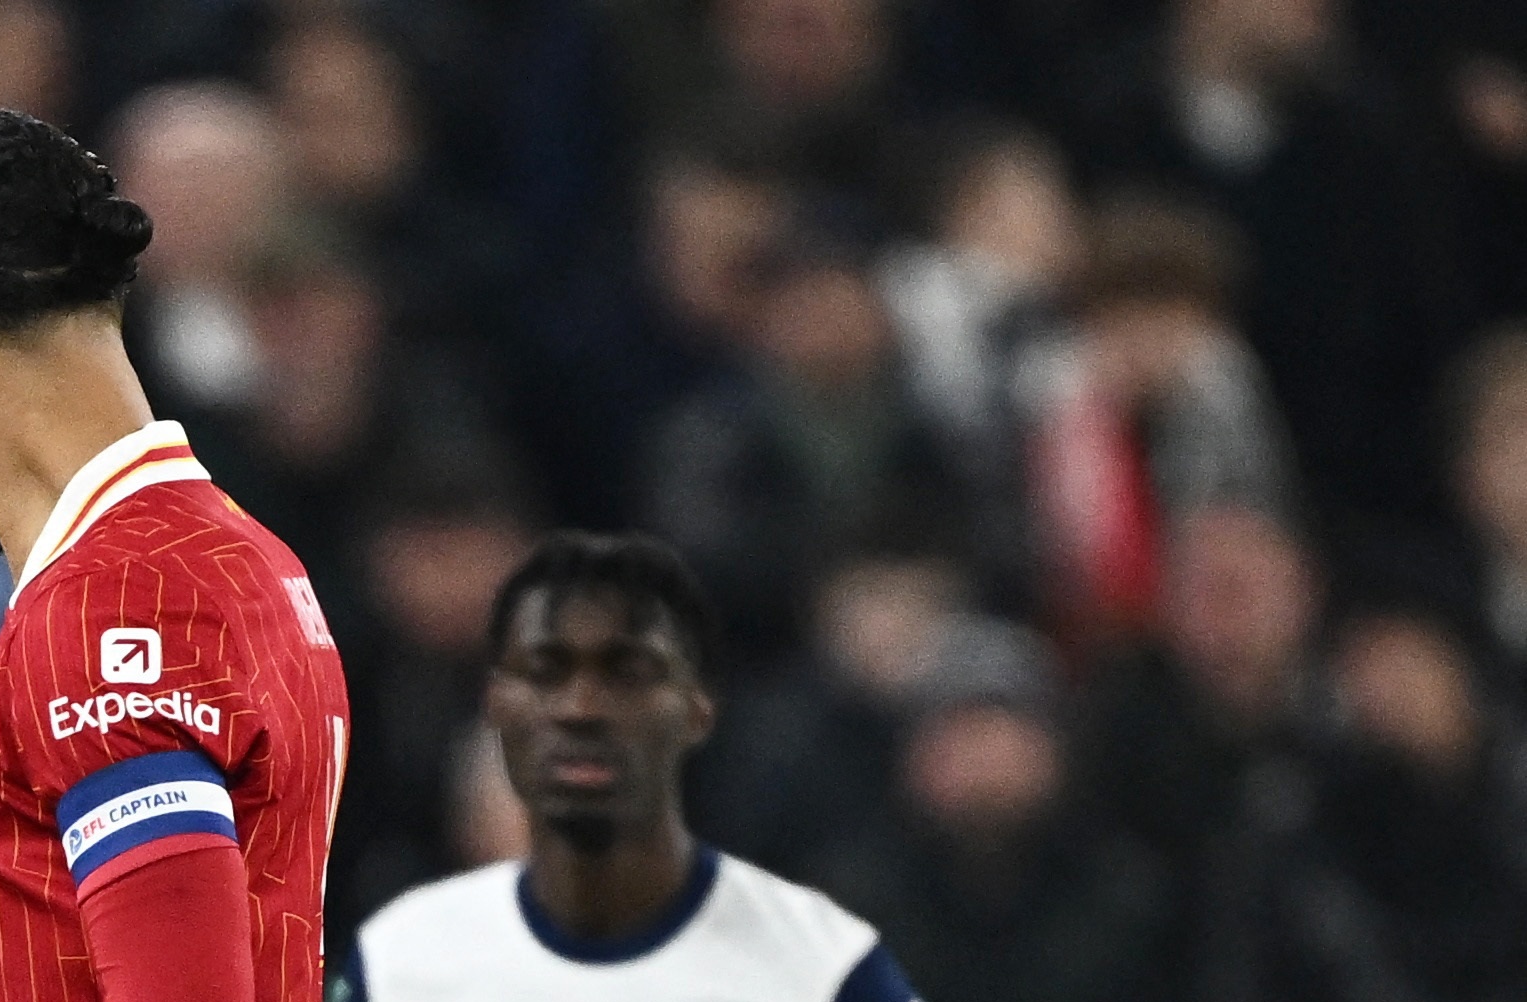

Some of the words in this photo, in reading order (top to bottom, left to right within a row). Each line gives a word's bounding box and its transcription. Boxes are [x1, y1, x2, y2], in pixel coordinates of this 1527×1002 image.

[48, 690, 221, 740] Expedia
[82, 817, 106, 840] EFL
[109, 790, 188, 823] CAPTAIN
